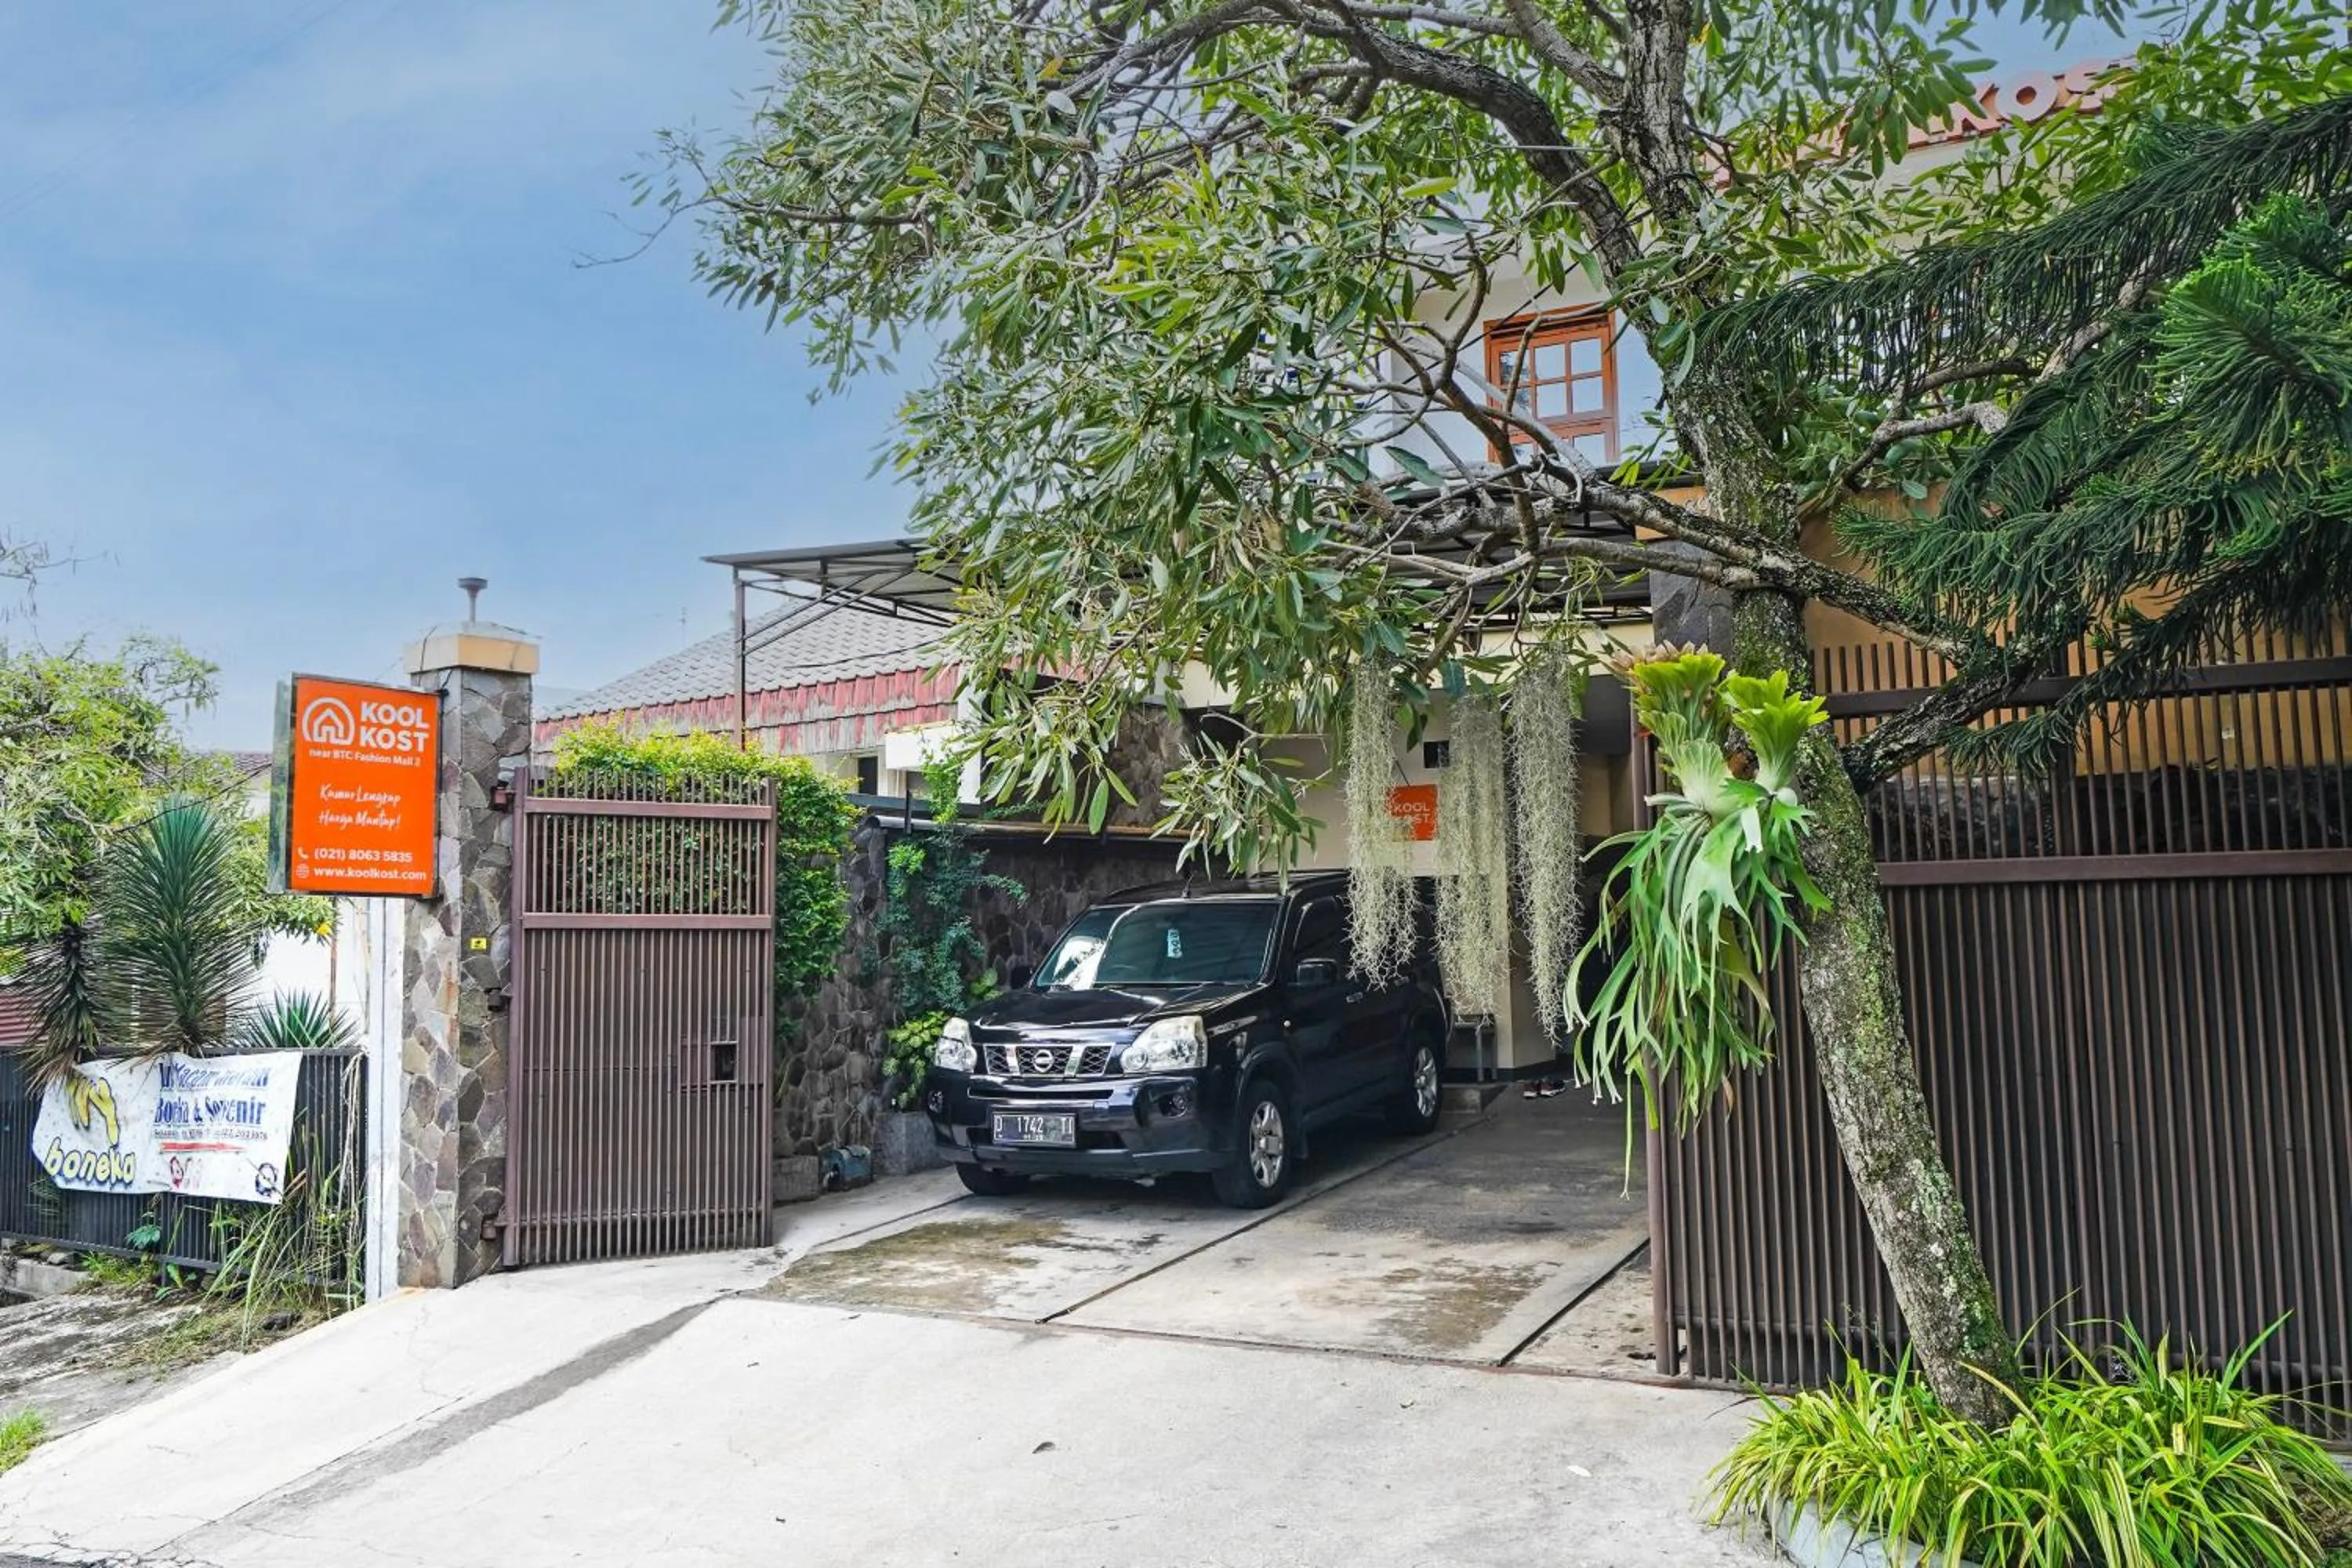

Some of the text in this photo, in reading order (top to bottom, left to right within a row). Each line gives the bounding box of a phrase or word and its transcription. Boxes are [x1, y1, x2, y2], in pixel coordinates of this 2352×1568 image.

[361, 702, 430, 729] KOOL
[360, 727, 429, 753] KOST
[309, 749, 331, 757] near
[333, 750, 353, 760] BTC
[355, 752, 391, 764] Fashion
[394, 756, 413, 766] Mall
[320, 784, 401, 808] Kamar Lengkap
[318, 809, 401, 831] Harga Mantap!
[314, 848, 412, 862] (021) 8063 5835
[314, 866, 426, 880] www.koolkost.com
[1018, 1116, 1044, 1133] 1742
[45, 1136, 136, 1187] boneka
